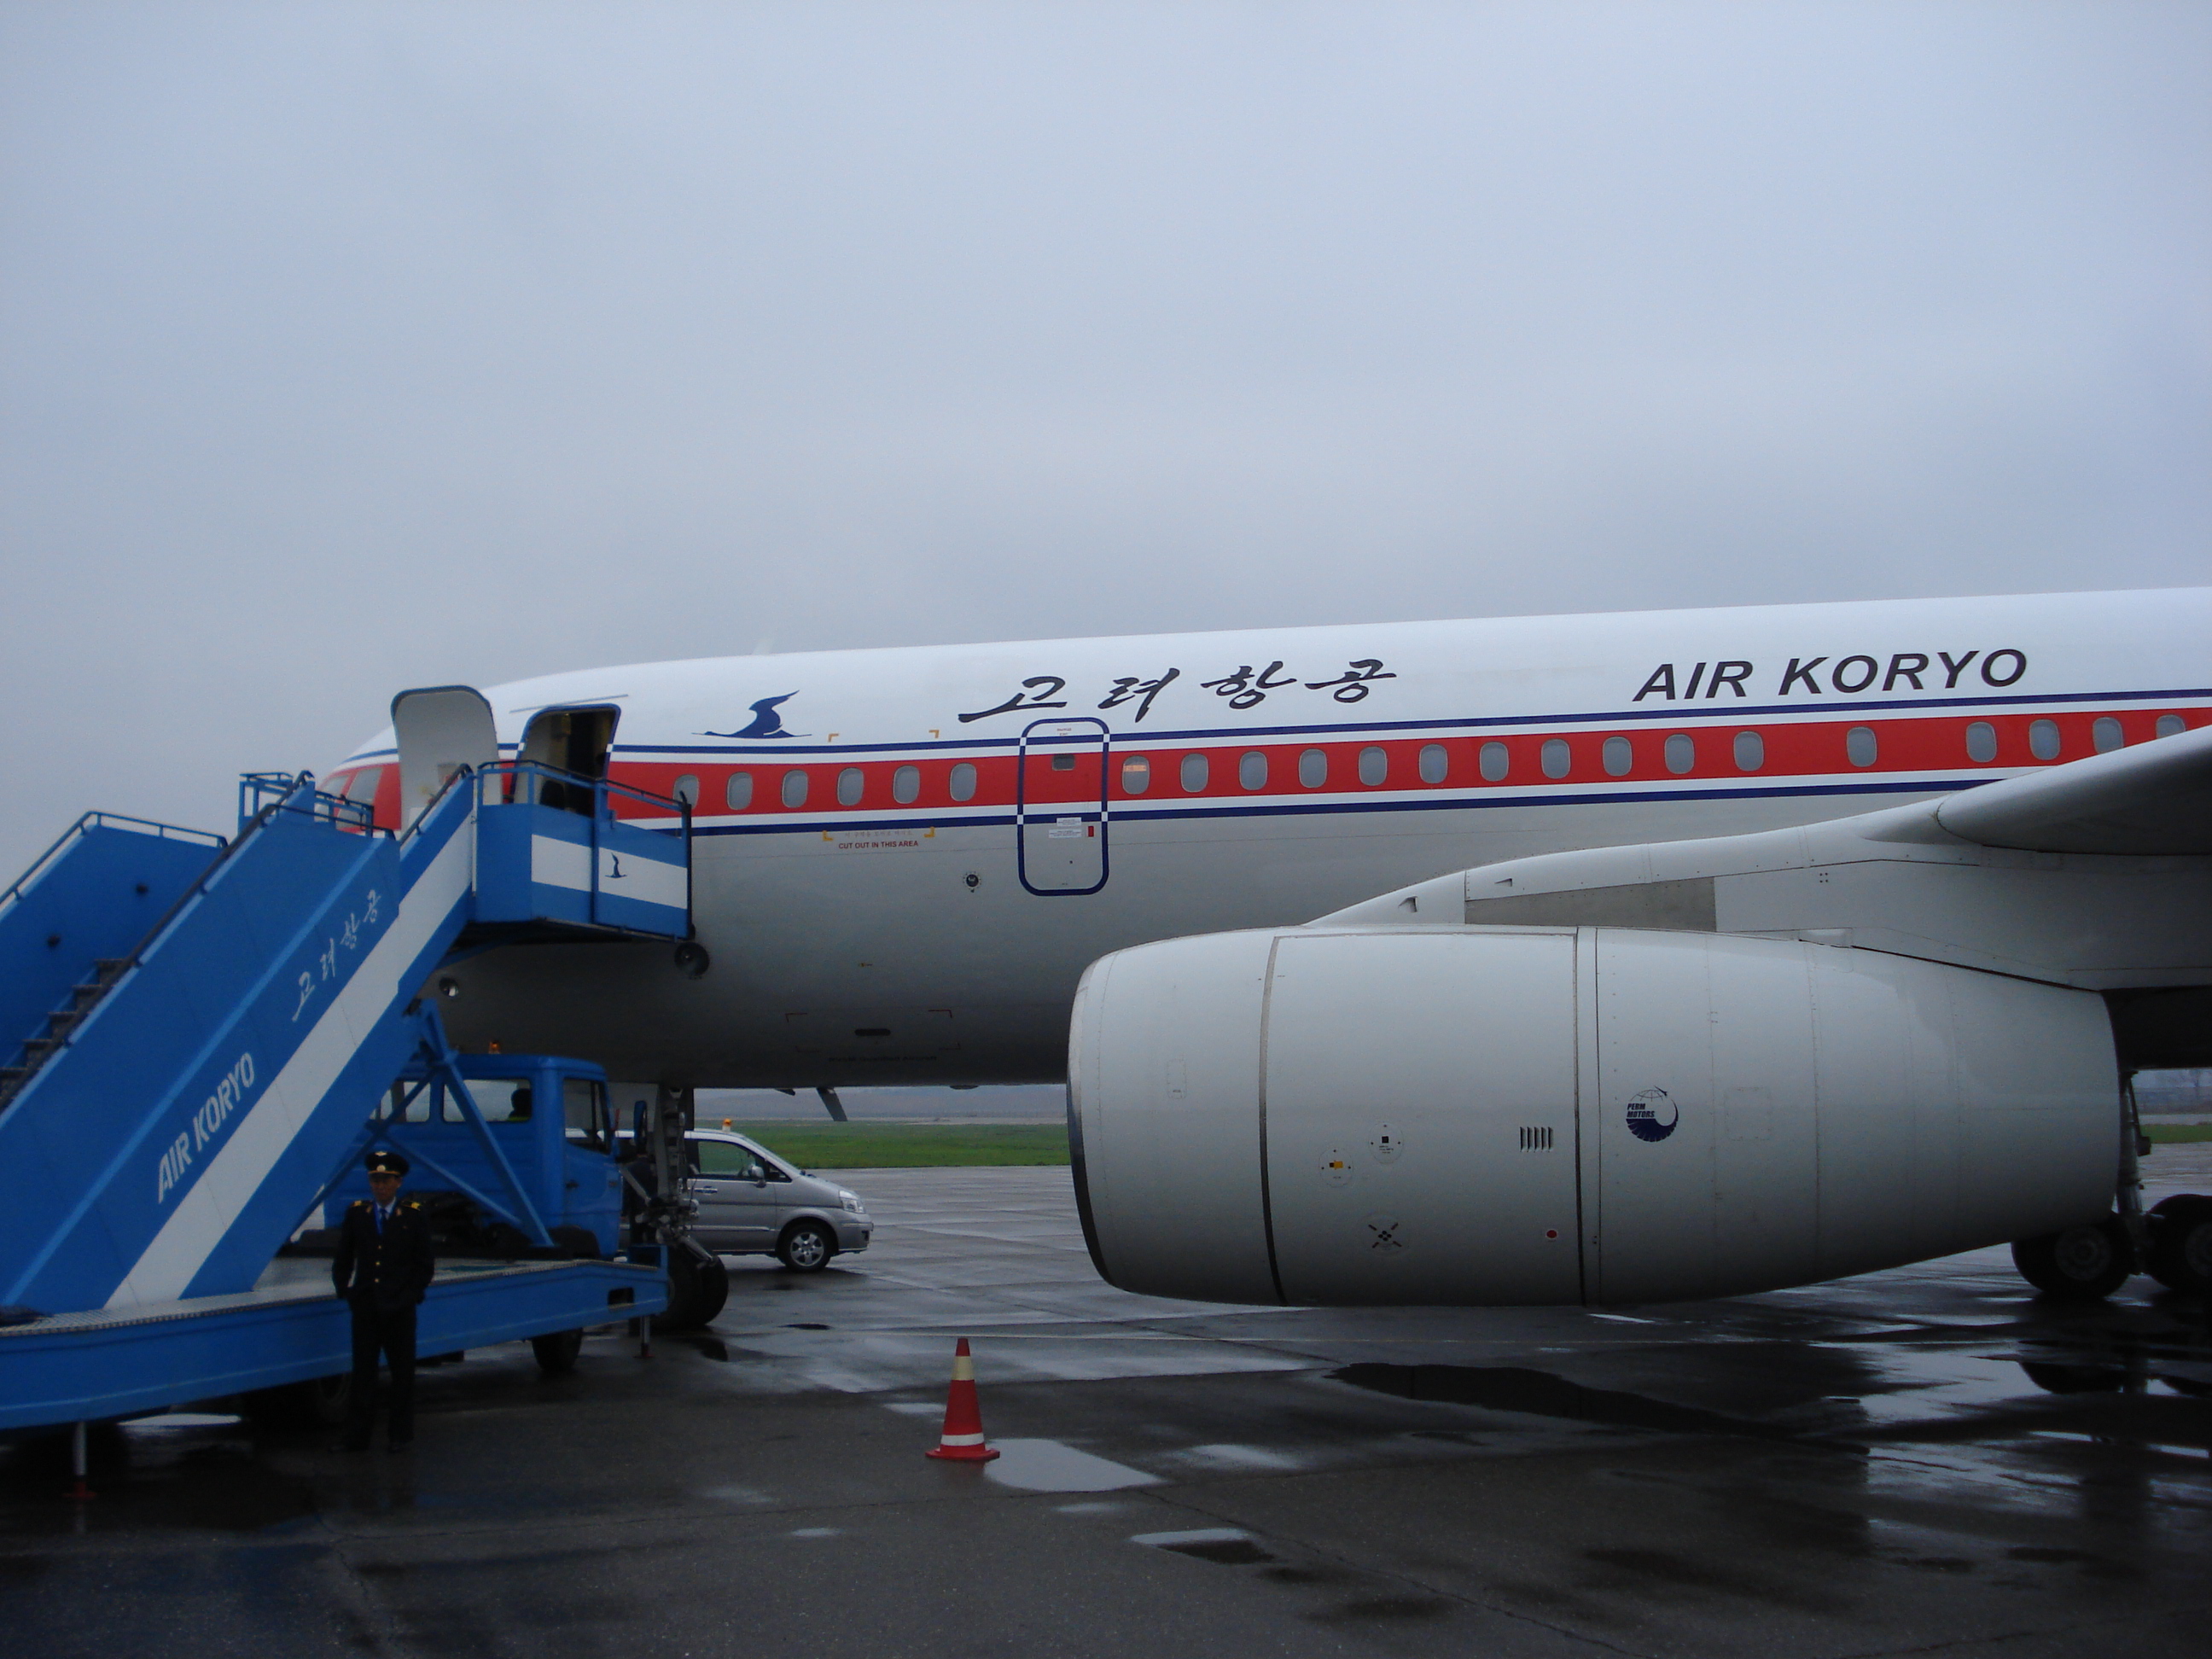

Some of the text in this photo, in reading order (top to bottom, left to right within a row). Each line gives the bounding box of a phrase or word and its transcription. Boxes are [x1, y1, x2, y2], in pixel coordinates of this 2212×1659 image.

[1632, 648, 2028, 702] AIR KORYO
[158, 1052, 255, 1204] AIR KORYO
